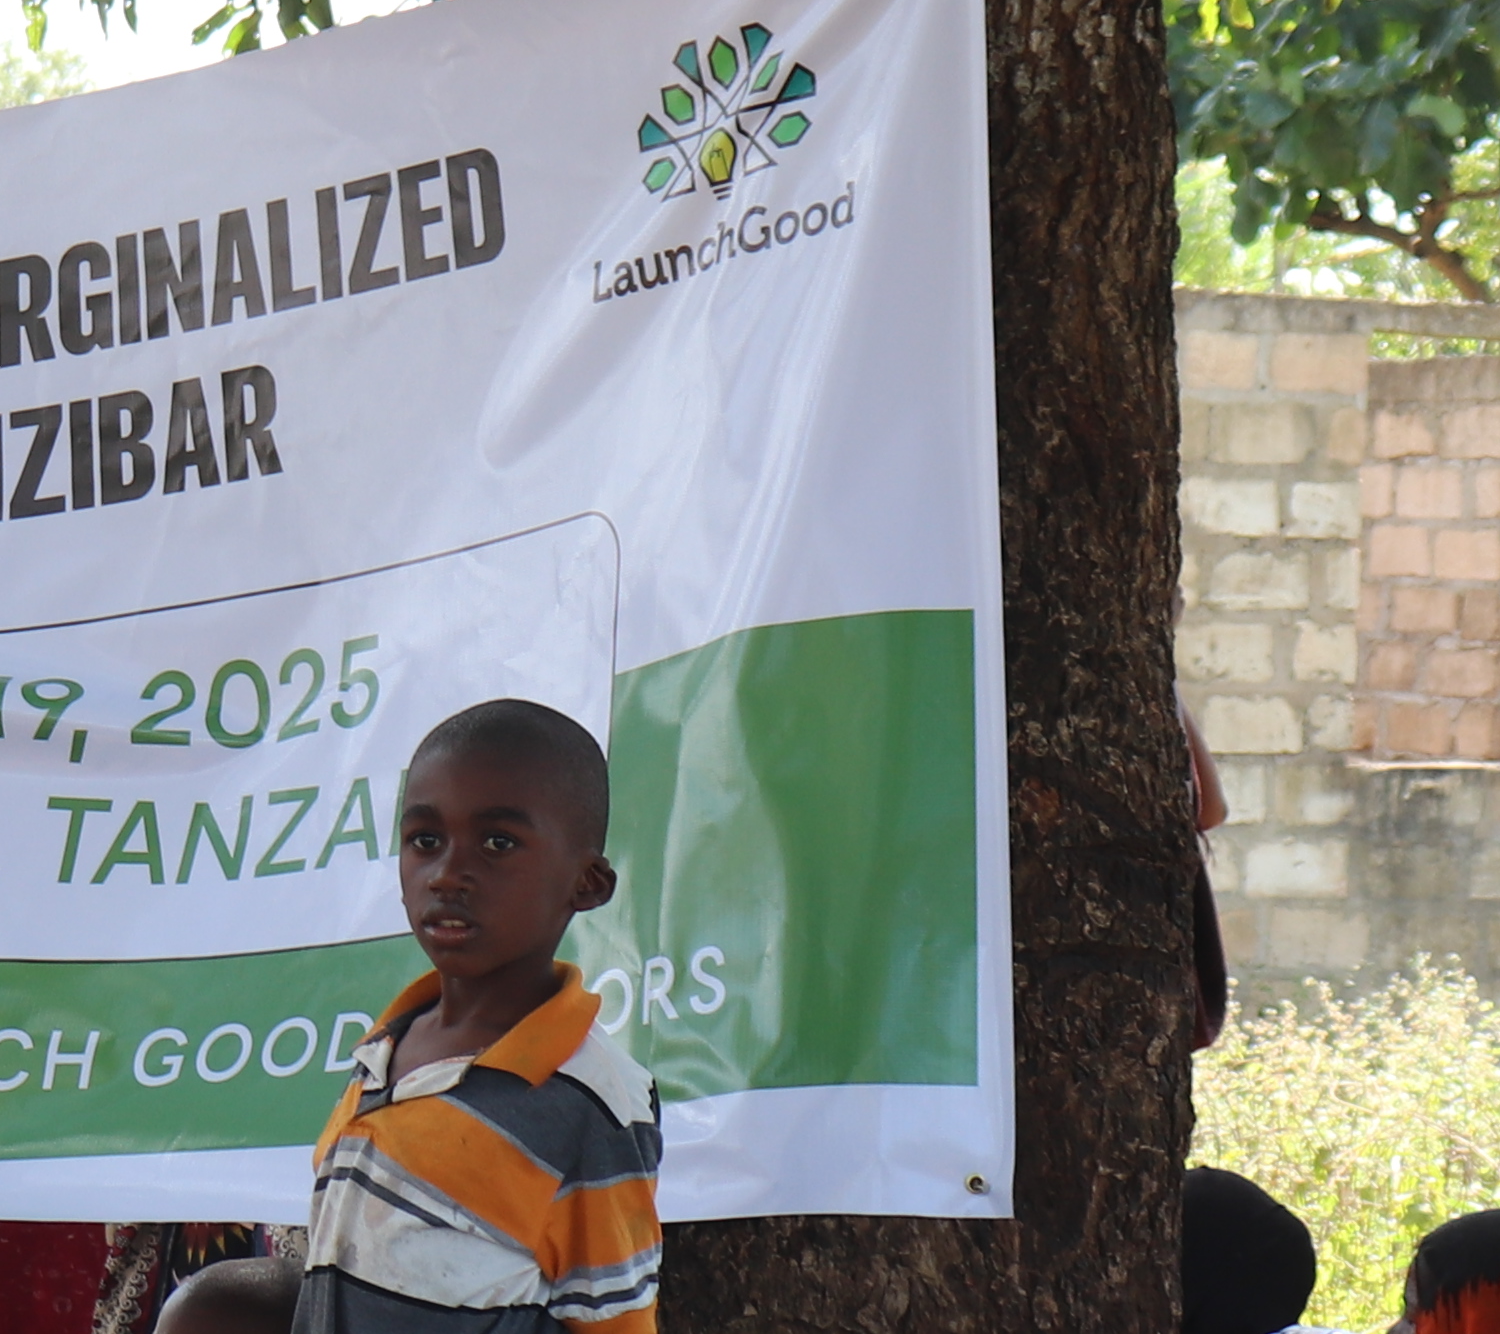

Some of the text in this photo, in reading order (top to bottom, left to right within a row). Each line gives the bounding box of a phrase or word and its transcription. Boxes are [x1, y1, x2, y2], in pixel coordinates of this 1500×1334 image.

[593, 181, 856, 304] LaunchGood
[130, 634, 380, 749] 2025
[45, 768, 409, 886] TANZA
[132, 1011, 375, 1086] GOOD
[590, 945, 727, 1036] ORS
